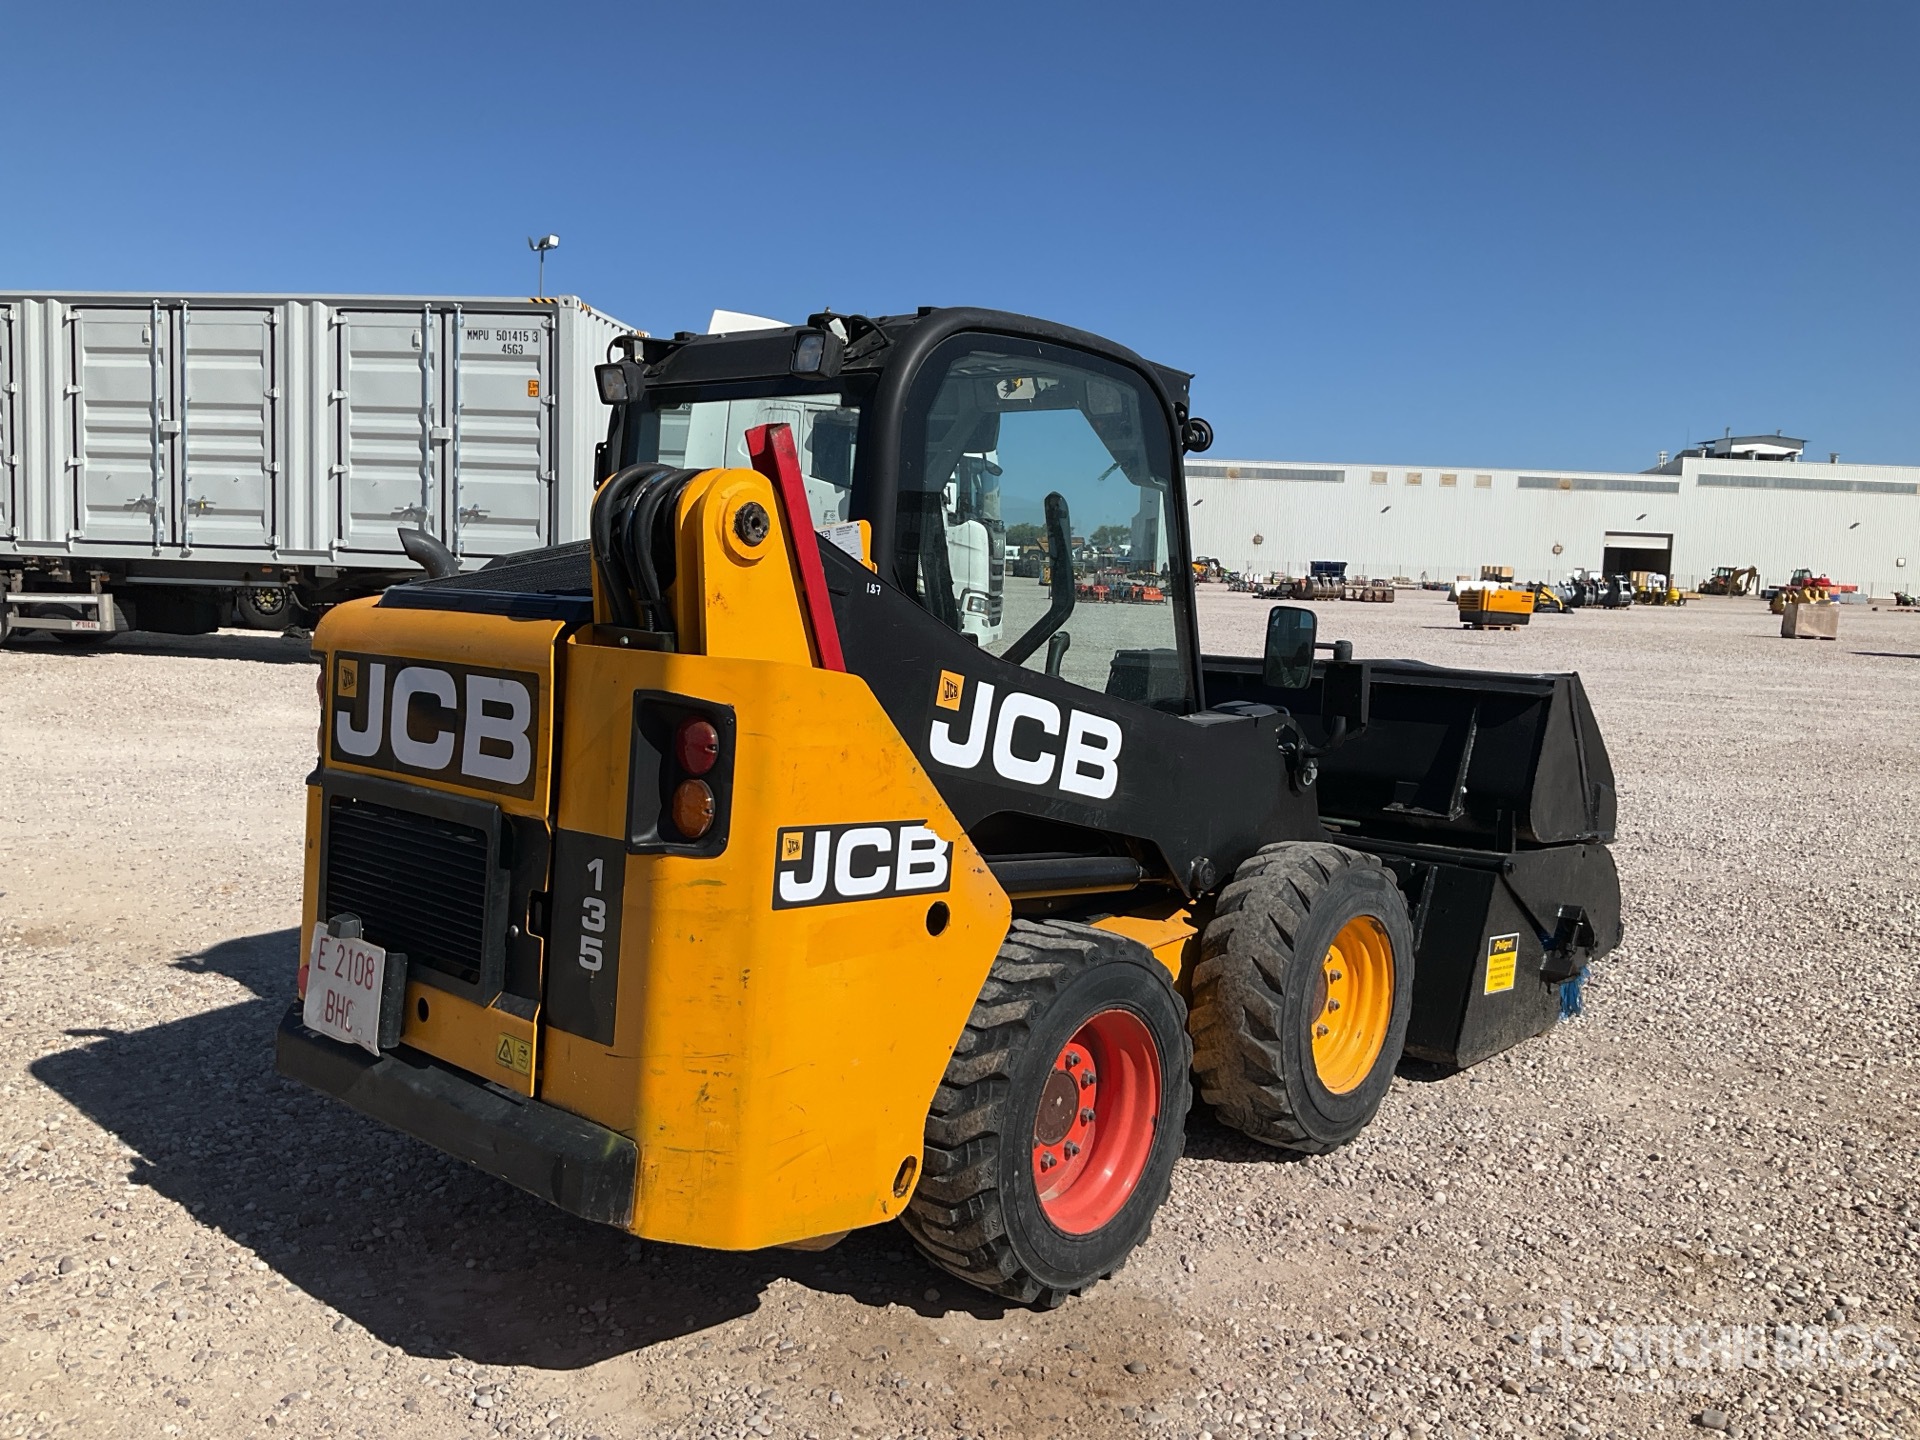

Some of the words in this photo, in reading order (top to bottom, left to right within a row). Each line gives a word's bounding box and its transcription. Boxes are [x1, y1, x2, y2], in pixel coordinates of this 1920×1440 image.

[467, 330, 489, 341] MMPU
[496, 330, 529, 342] 501415
[532, 331, 539, 342] 3
[501, 344, 524, 355] 45G3
[944, 680, 958, 699] JCB
[336, 662, 531, 785] JCB
[930, 681, 1123, 799] JCB
[779, 825, 949, 902] JCB
[787, 838, 800, 854] JCB
[578, 858, 607, 972] 135
[317, 936, 329, 971] E
[334, 944, 375, 991] 2108
[324, 989, 354, 1033] BHC
